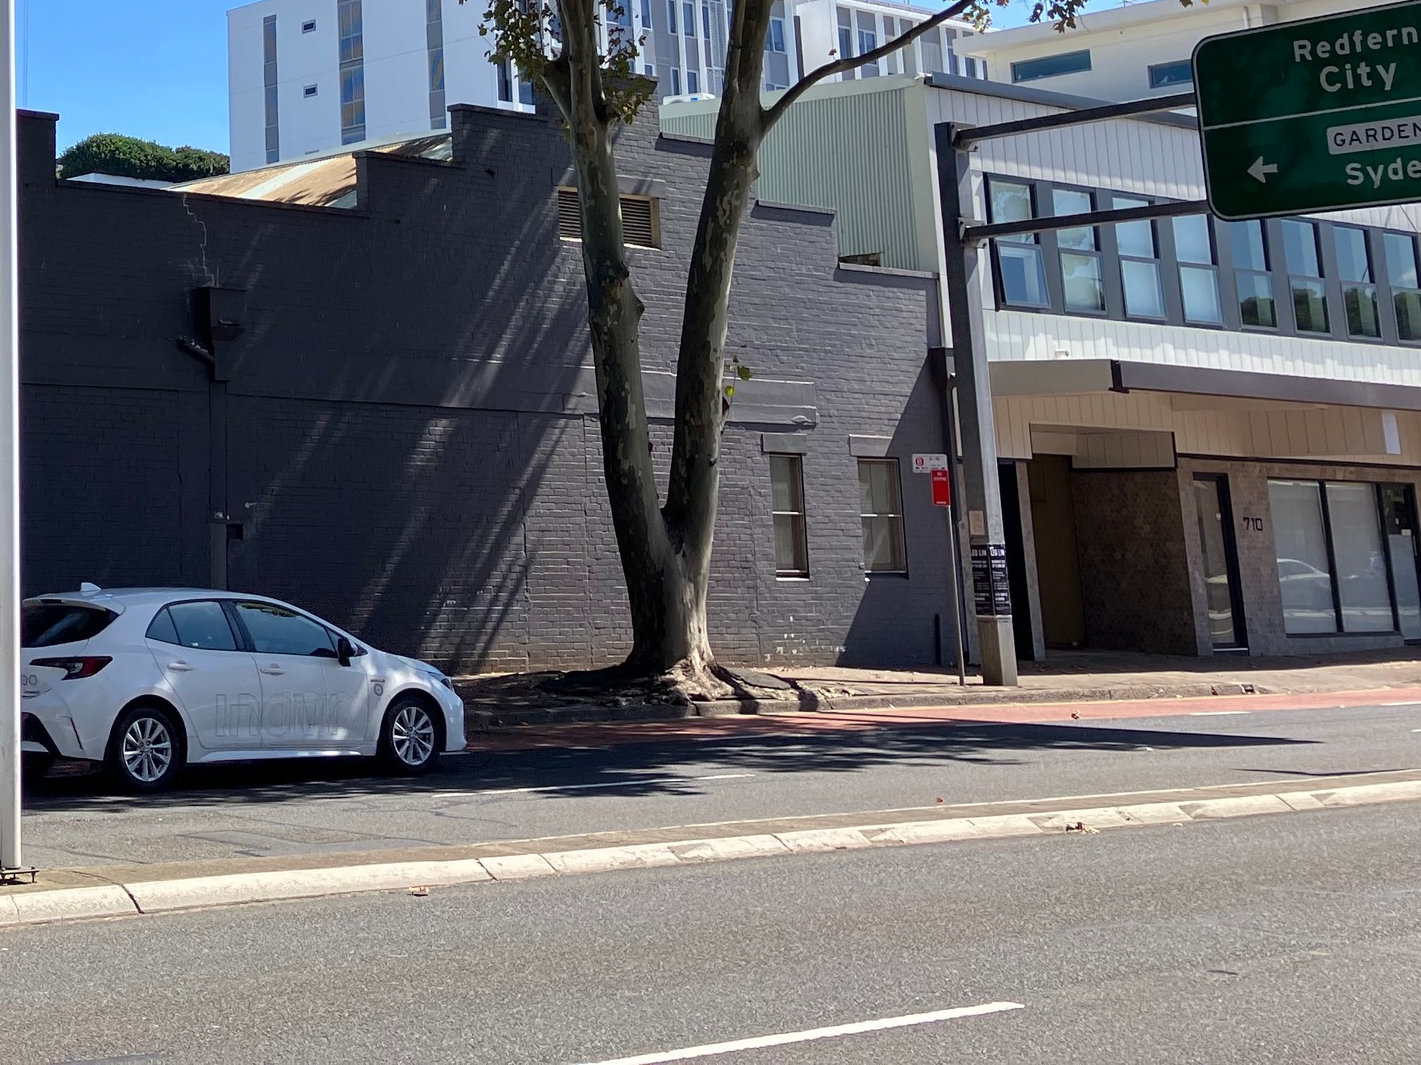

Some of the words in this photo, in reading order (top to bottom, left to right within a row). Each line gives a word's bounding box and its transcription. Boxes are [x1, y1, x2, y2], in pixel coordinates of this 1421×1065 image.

[1293, 26, 1419, 62] Redfern
[1319, 62, 1397, 92] City
[1243, 516, 1264, 532] 710
